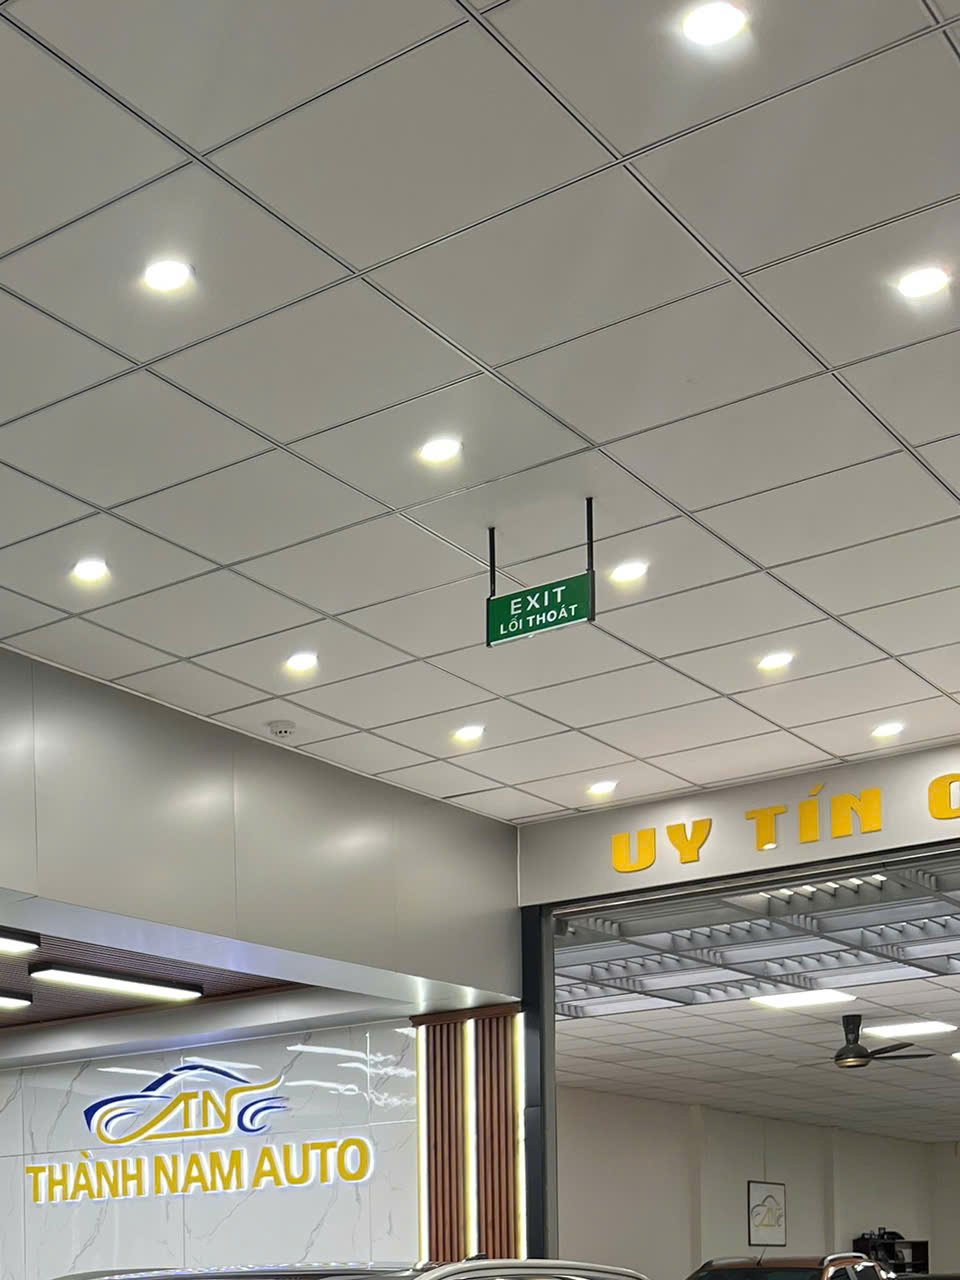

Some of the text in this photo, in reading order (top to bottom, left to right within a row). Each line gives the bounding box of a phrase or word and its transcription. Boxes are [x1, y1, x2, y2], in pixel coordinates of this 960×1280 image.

[500, 604, 578, 635] LỐI THOÁT
[510, 586, 566, 615] EXIT
[611, 818, 713, 873] UY
[744, 782, 882, 852] TÍN
[25, 1137, 373, 1204] THÀNH NAM AUTO
